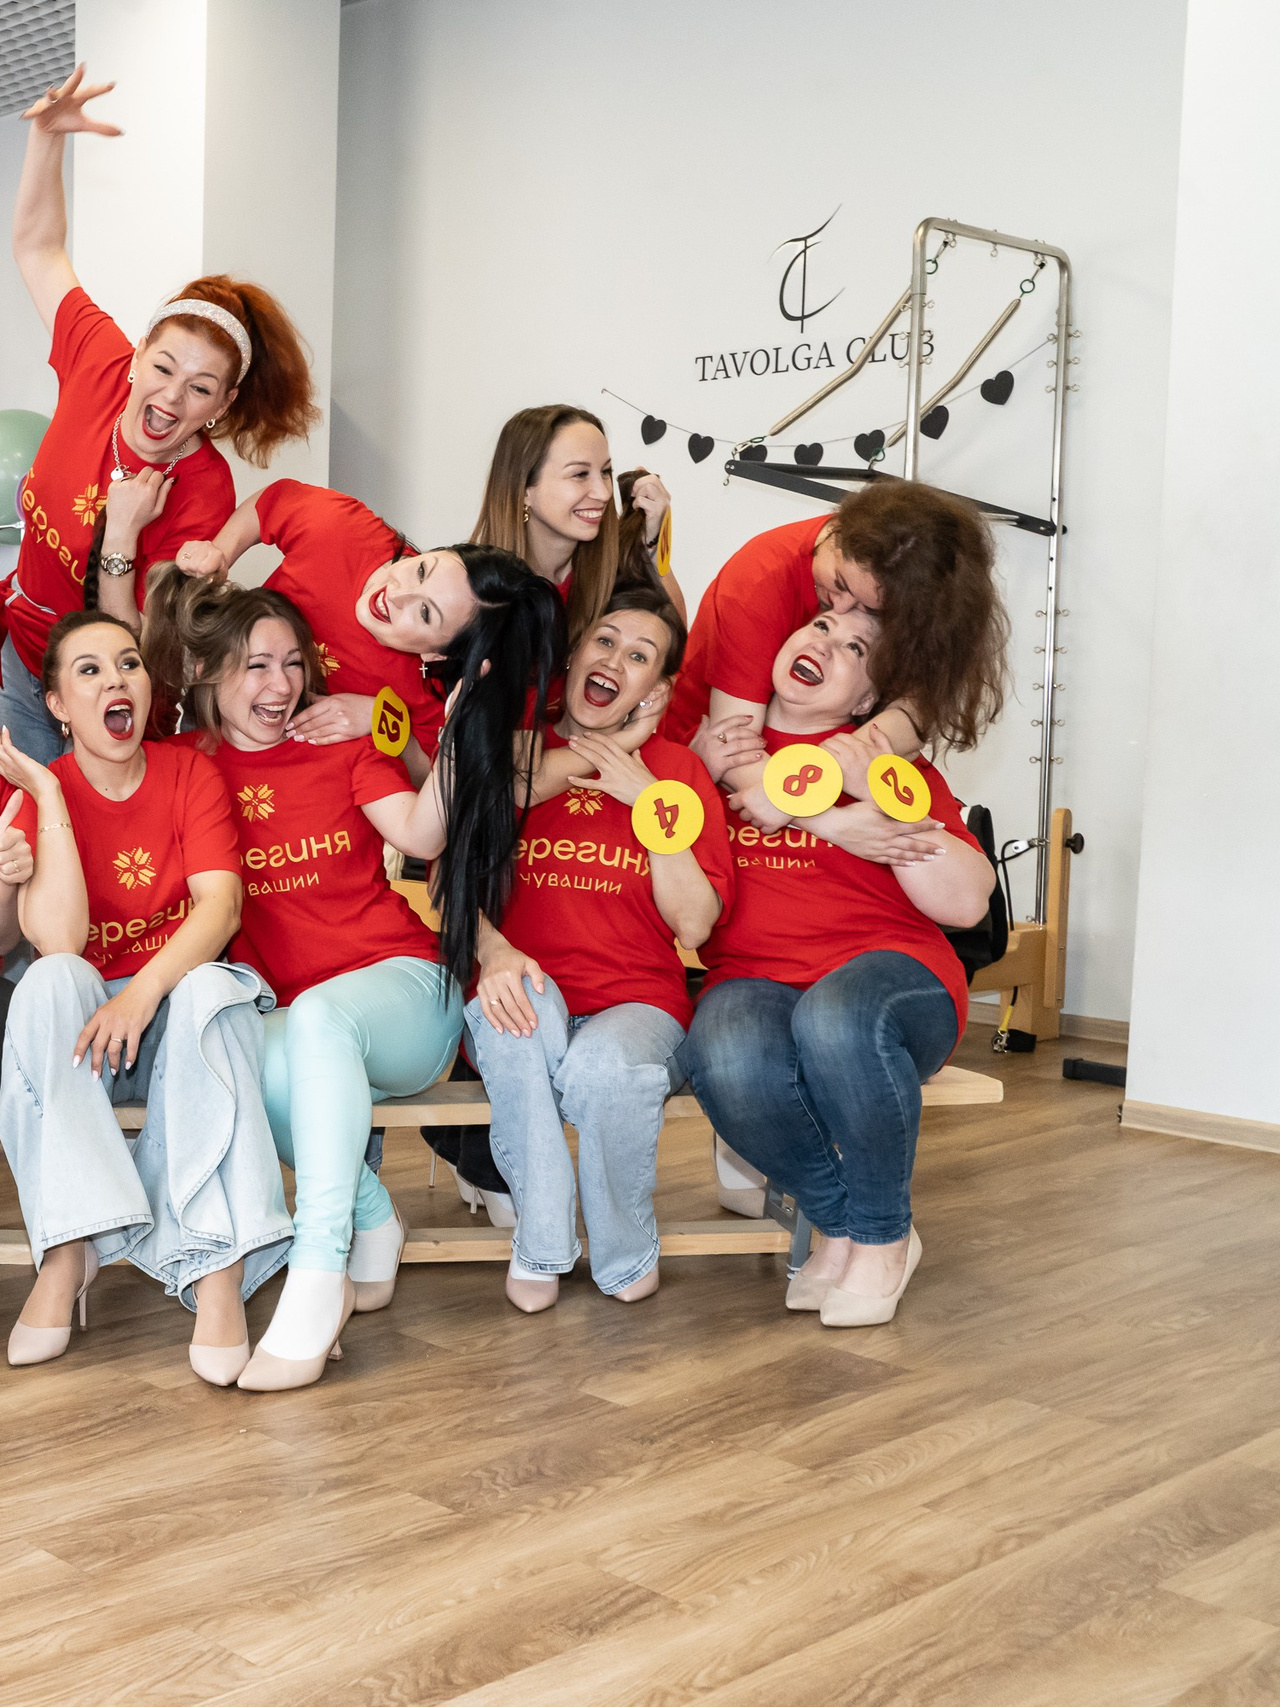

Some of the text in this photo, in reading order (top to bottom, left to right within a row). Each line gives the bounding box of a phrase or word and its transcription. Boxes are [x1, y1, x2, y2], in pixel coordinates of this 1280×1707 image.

[694, 341, 835, 382] TAVOLGA
[783, 764, 823, 797] 8
[653, 797, 679, 839] 4
[240, 830, 352, 870] егиня
[737, 856, 816, 870] вашии
[246, 871, 320, 897] вашии
[519, 872, 623, 896] чувашии
